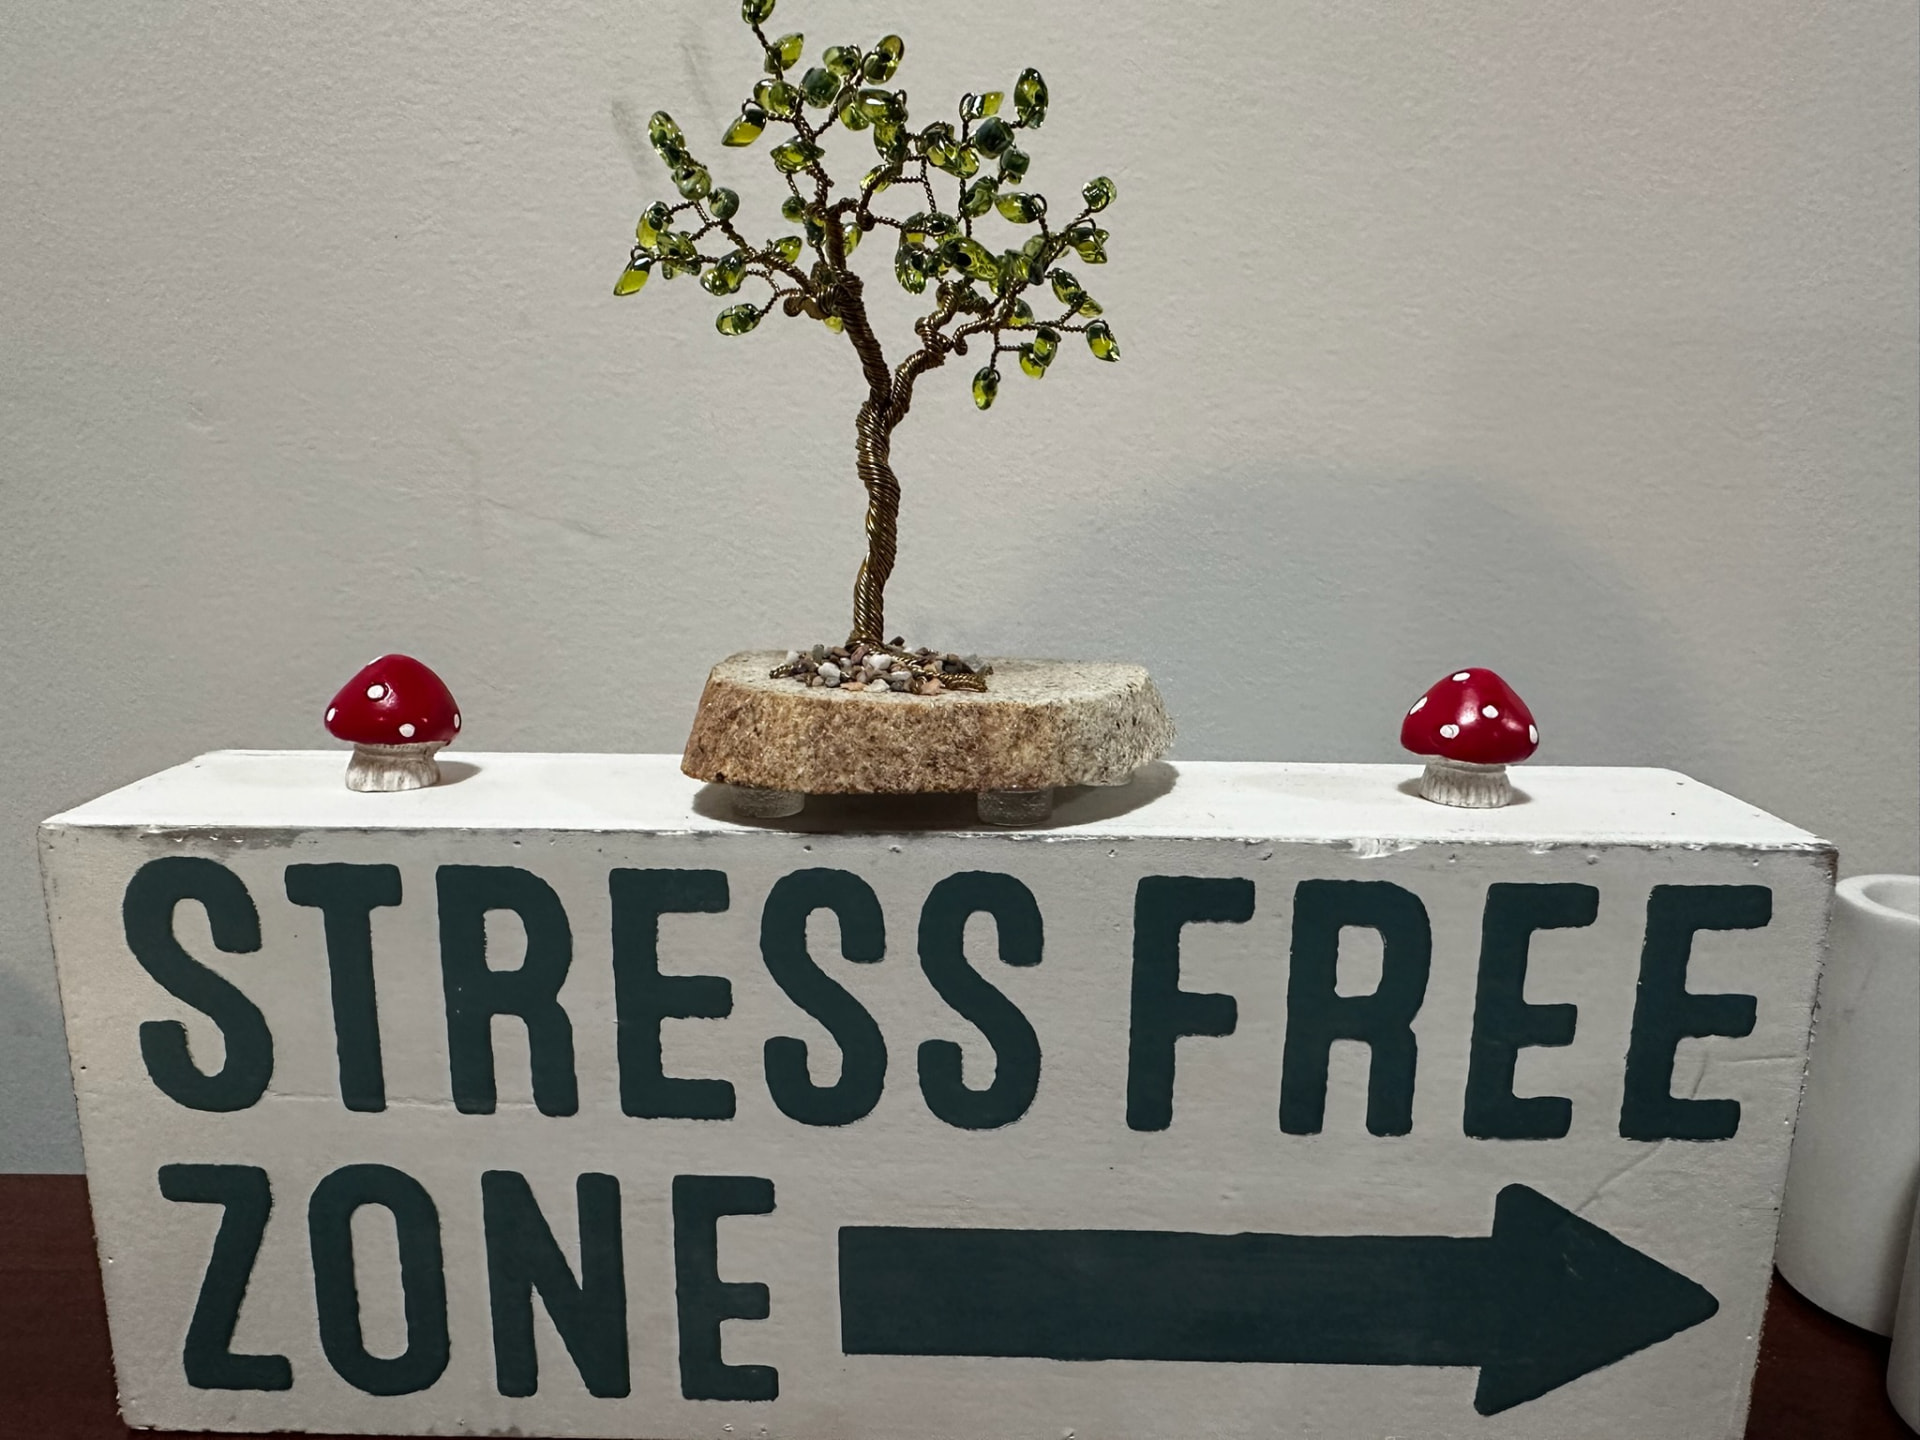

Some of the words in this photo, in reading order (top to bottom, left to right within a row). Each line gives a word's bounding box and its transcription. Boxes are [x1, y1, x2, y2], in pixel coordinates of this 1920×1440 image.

[123, 856, 1044, 1131] STRESS
[1126, 875, 1772, 1143] FREE
[158, 1163, 779, 1403] ZONE
